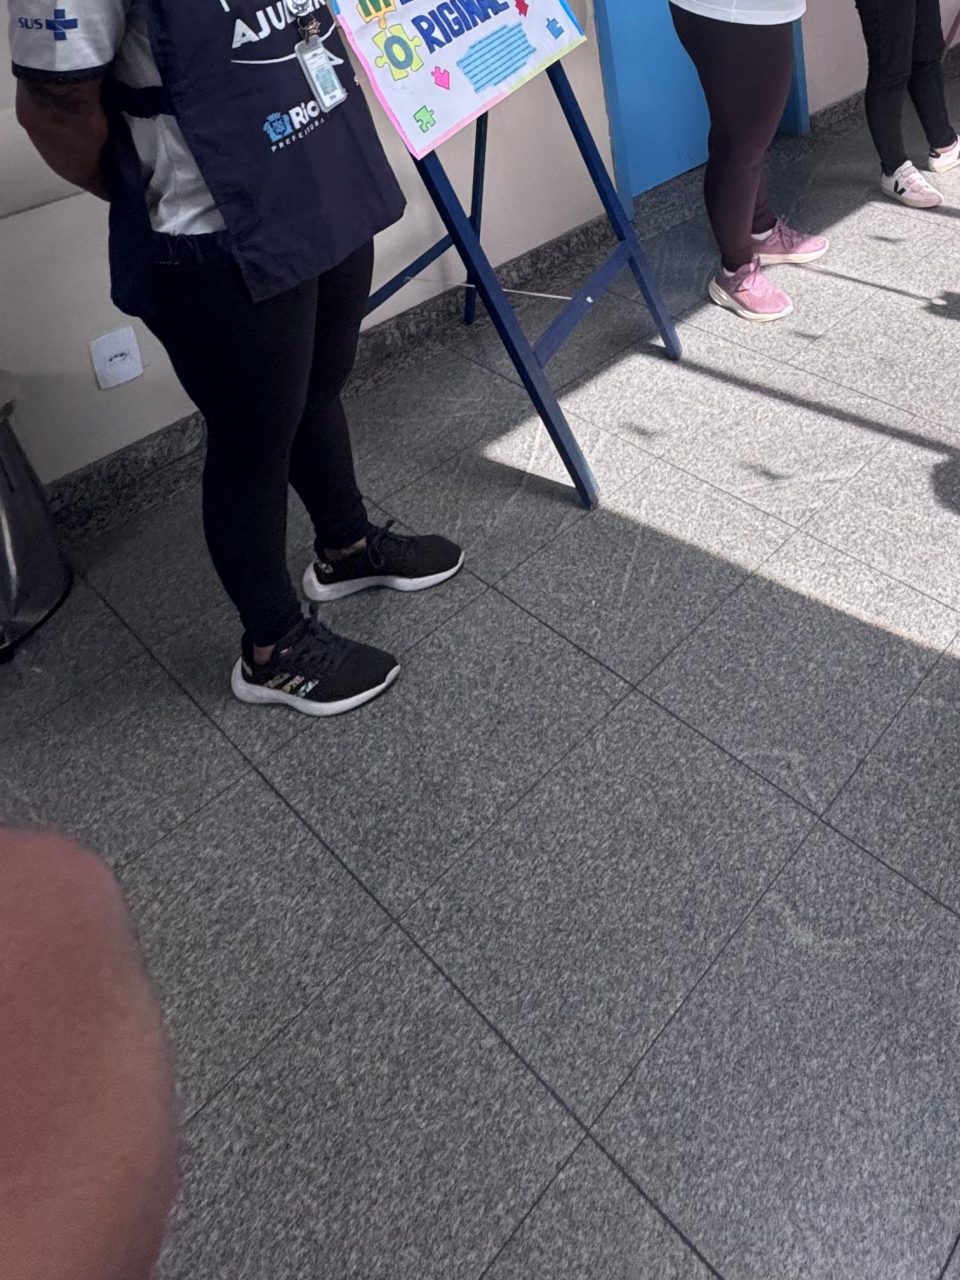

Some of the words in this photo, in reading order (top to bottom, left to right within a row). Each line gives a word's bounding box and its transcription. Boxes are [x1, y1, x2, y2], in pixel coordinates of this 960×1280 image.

[17, 17, 44, 31] SUS
[288, 100, 321, 129] Rio
[270, 117, 326, 153] PREFEITURA
